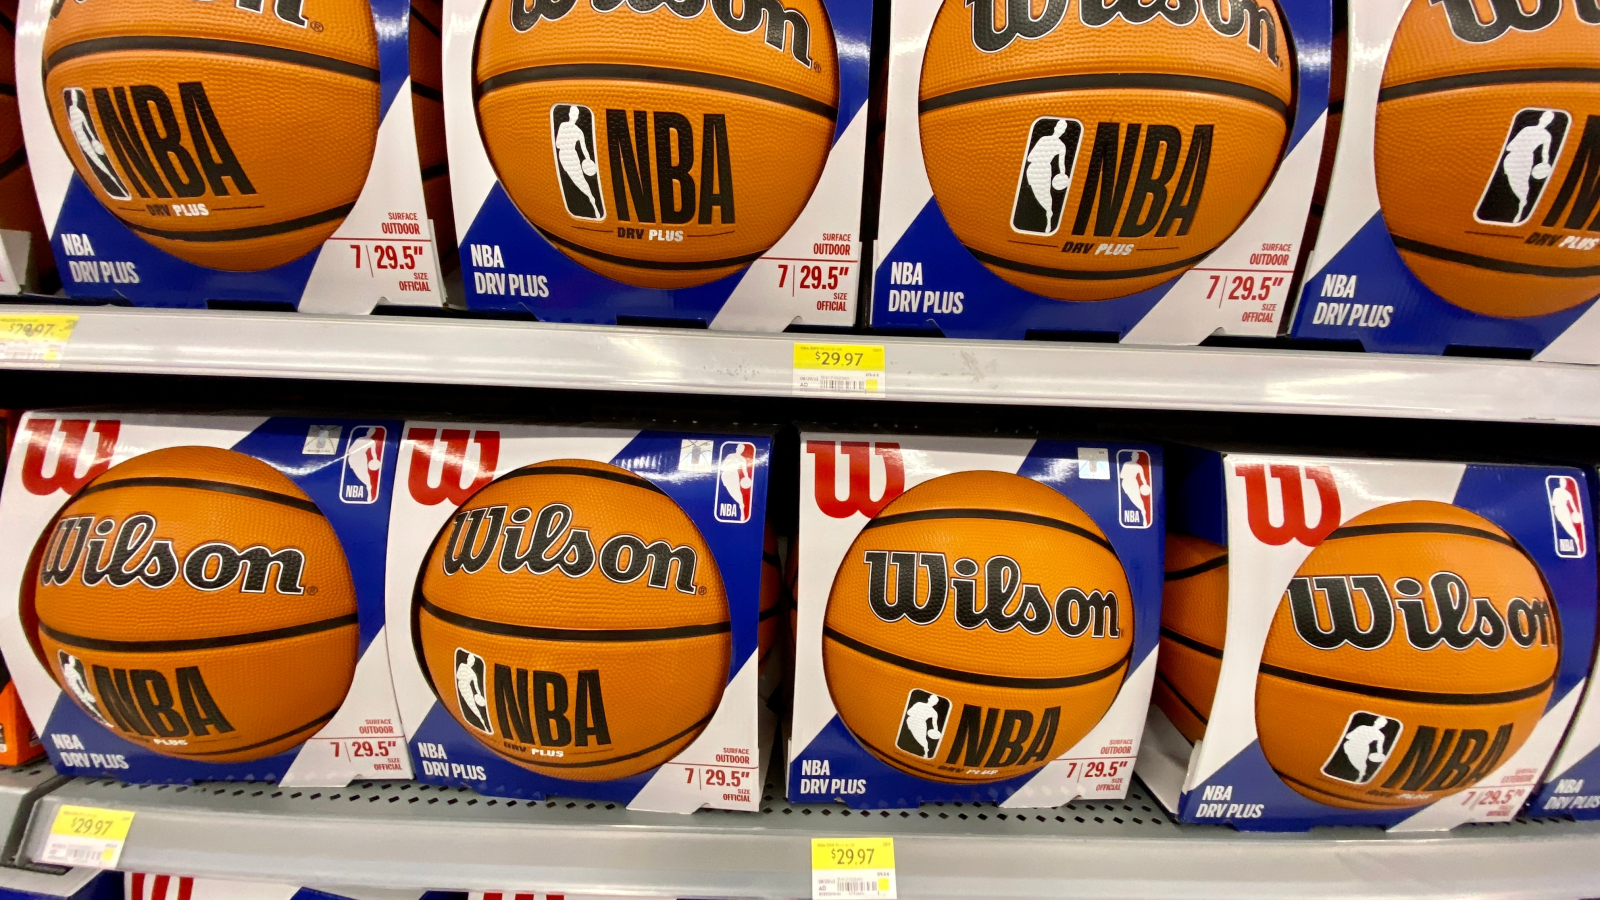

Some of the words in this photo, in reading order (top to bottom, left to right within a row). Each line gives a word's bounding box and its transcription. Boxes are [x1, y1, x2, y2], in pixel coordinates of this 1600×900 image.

[92, 81, 258, 200] NBA
[605, 108, 736, 225] NBA
[1072, 121, 1215, 238] NBA
[146, 204, 171, 217] DRV
[173, 203, 210, 217] PLUS
[388, 212, 418, 222] SURFACE
[381, 223, 421, 236] OUTDOOR
[617, 227, 645, 240] DRV
[648, 229, 684, 242] PLUS
[822, 233, 851, 242] SURFACE
[61, 233, 95, 256] NBA
[813, 243, 851, 256] OUTDOOR
[1062, 241, 1095, 255] DRV
[1094, 242, 1135, 256] PLUS
[1261, 243, 1292, 253] SURFACE
[1558, 235, 1600, 251] PLUS
[350, 245, 362, 269] 7
[374, 245, 424, 271] 29.5"
[471, 244, 504, 268] NBA
[1249, 253, 1290, 267] OUTDOOR
[69, 260, 101, 284] DRV
[100, 262, 140, 284] PLUS
[413, 272, 429, 281] SIZE
[778, 265, 788, 288] 7
[800, 265, 849, 291] 29.5"
[891, 262, 923, 286] NBA
[399, 281, 431, 292] OFFICIAL
[474, 273, 506, 297] DRV
[510, 274, 549, 298] PLUS
[1206, 276, 1221, 300] 7
[1228, 276, 1284, 301] 29.5"
[1320, 274, 1357, 299] NBA
[816, 300, 847, 312] OFFICIAL
[888, 291, 920, 313] DRV
[922, 291, 964, 314] PLUS
[1261, 304, 1276, 312] SIZE
[1242, 312, 1274, 323] OFFICIAL
[1312, 302, 1352, 326] DRV
[1348, 304, 1394, 328] PLUS
[815, 350, 864, 367] $29.97
[345, 485, 364, 498] NBA
[720, 503, 737, 517] NBA
[1124, 509, 1141, 523] NBA
[40, 513, 305, 595] Wilson
[443, 502, 698, 595] Wilson
[864, 549, 1120, 638] Wilson
[90, 664, 236, 738] NBA
[494, 662, 612, 748] NBA
[359, 725, 394, 734] OUTDOOR
[946, 703, 1061, 768] NBA
[51, 733, 84, 750] NBA
[330, 741, 340, 758] 7
[352, 741, 397, 757] 29.5"
[418, 741, 447, 760] NBA
[531, 748, 564, 757] PLUS
[715, 754, 750, 764] OUTDOOR
[1100, 746, 1132, 755] OUTDOOR
[1381, 722, 1515, 792] NBA
[60, 751, 94, 768] DRV
[90, 753, 130, 769] PLUS
[374, 763, 403, 771] OFFICIAL
[802, 759, 830, 776] NBA
[422, 761, 452, 778] DRV
[452, 762, 487, 781] PLUS
[685, 768, 694, 784] 7
[705, 769, 750, 787] 29.5"
[1067, 763, 1078, 778] 7
[1084, 761, 1128, 778] 29.5"
[800, 778, 830, 794] DRV
[830, 778, 866, 795] PLUS
[1203, 784, 1233, 800] NBA
[1553, 779, 1585, 794] NBA
[723, 794, 751, 802] OFFICIAL
[1568, 795, 1600, 810] PLUS
[1196, 803, 1228, 817] DRV
[1226, 803, 1265, 818] PLUS
[71, 817, 114, 836] $29.97
[831, 848, 875, 866] $29.97
